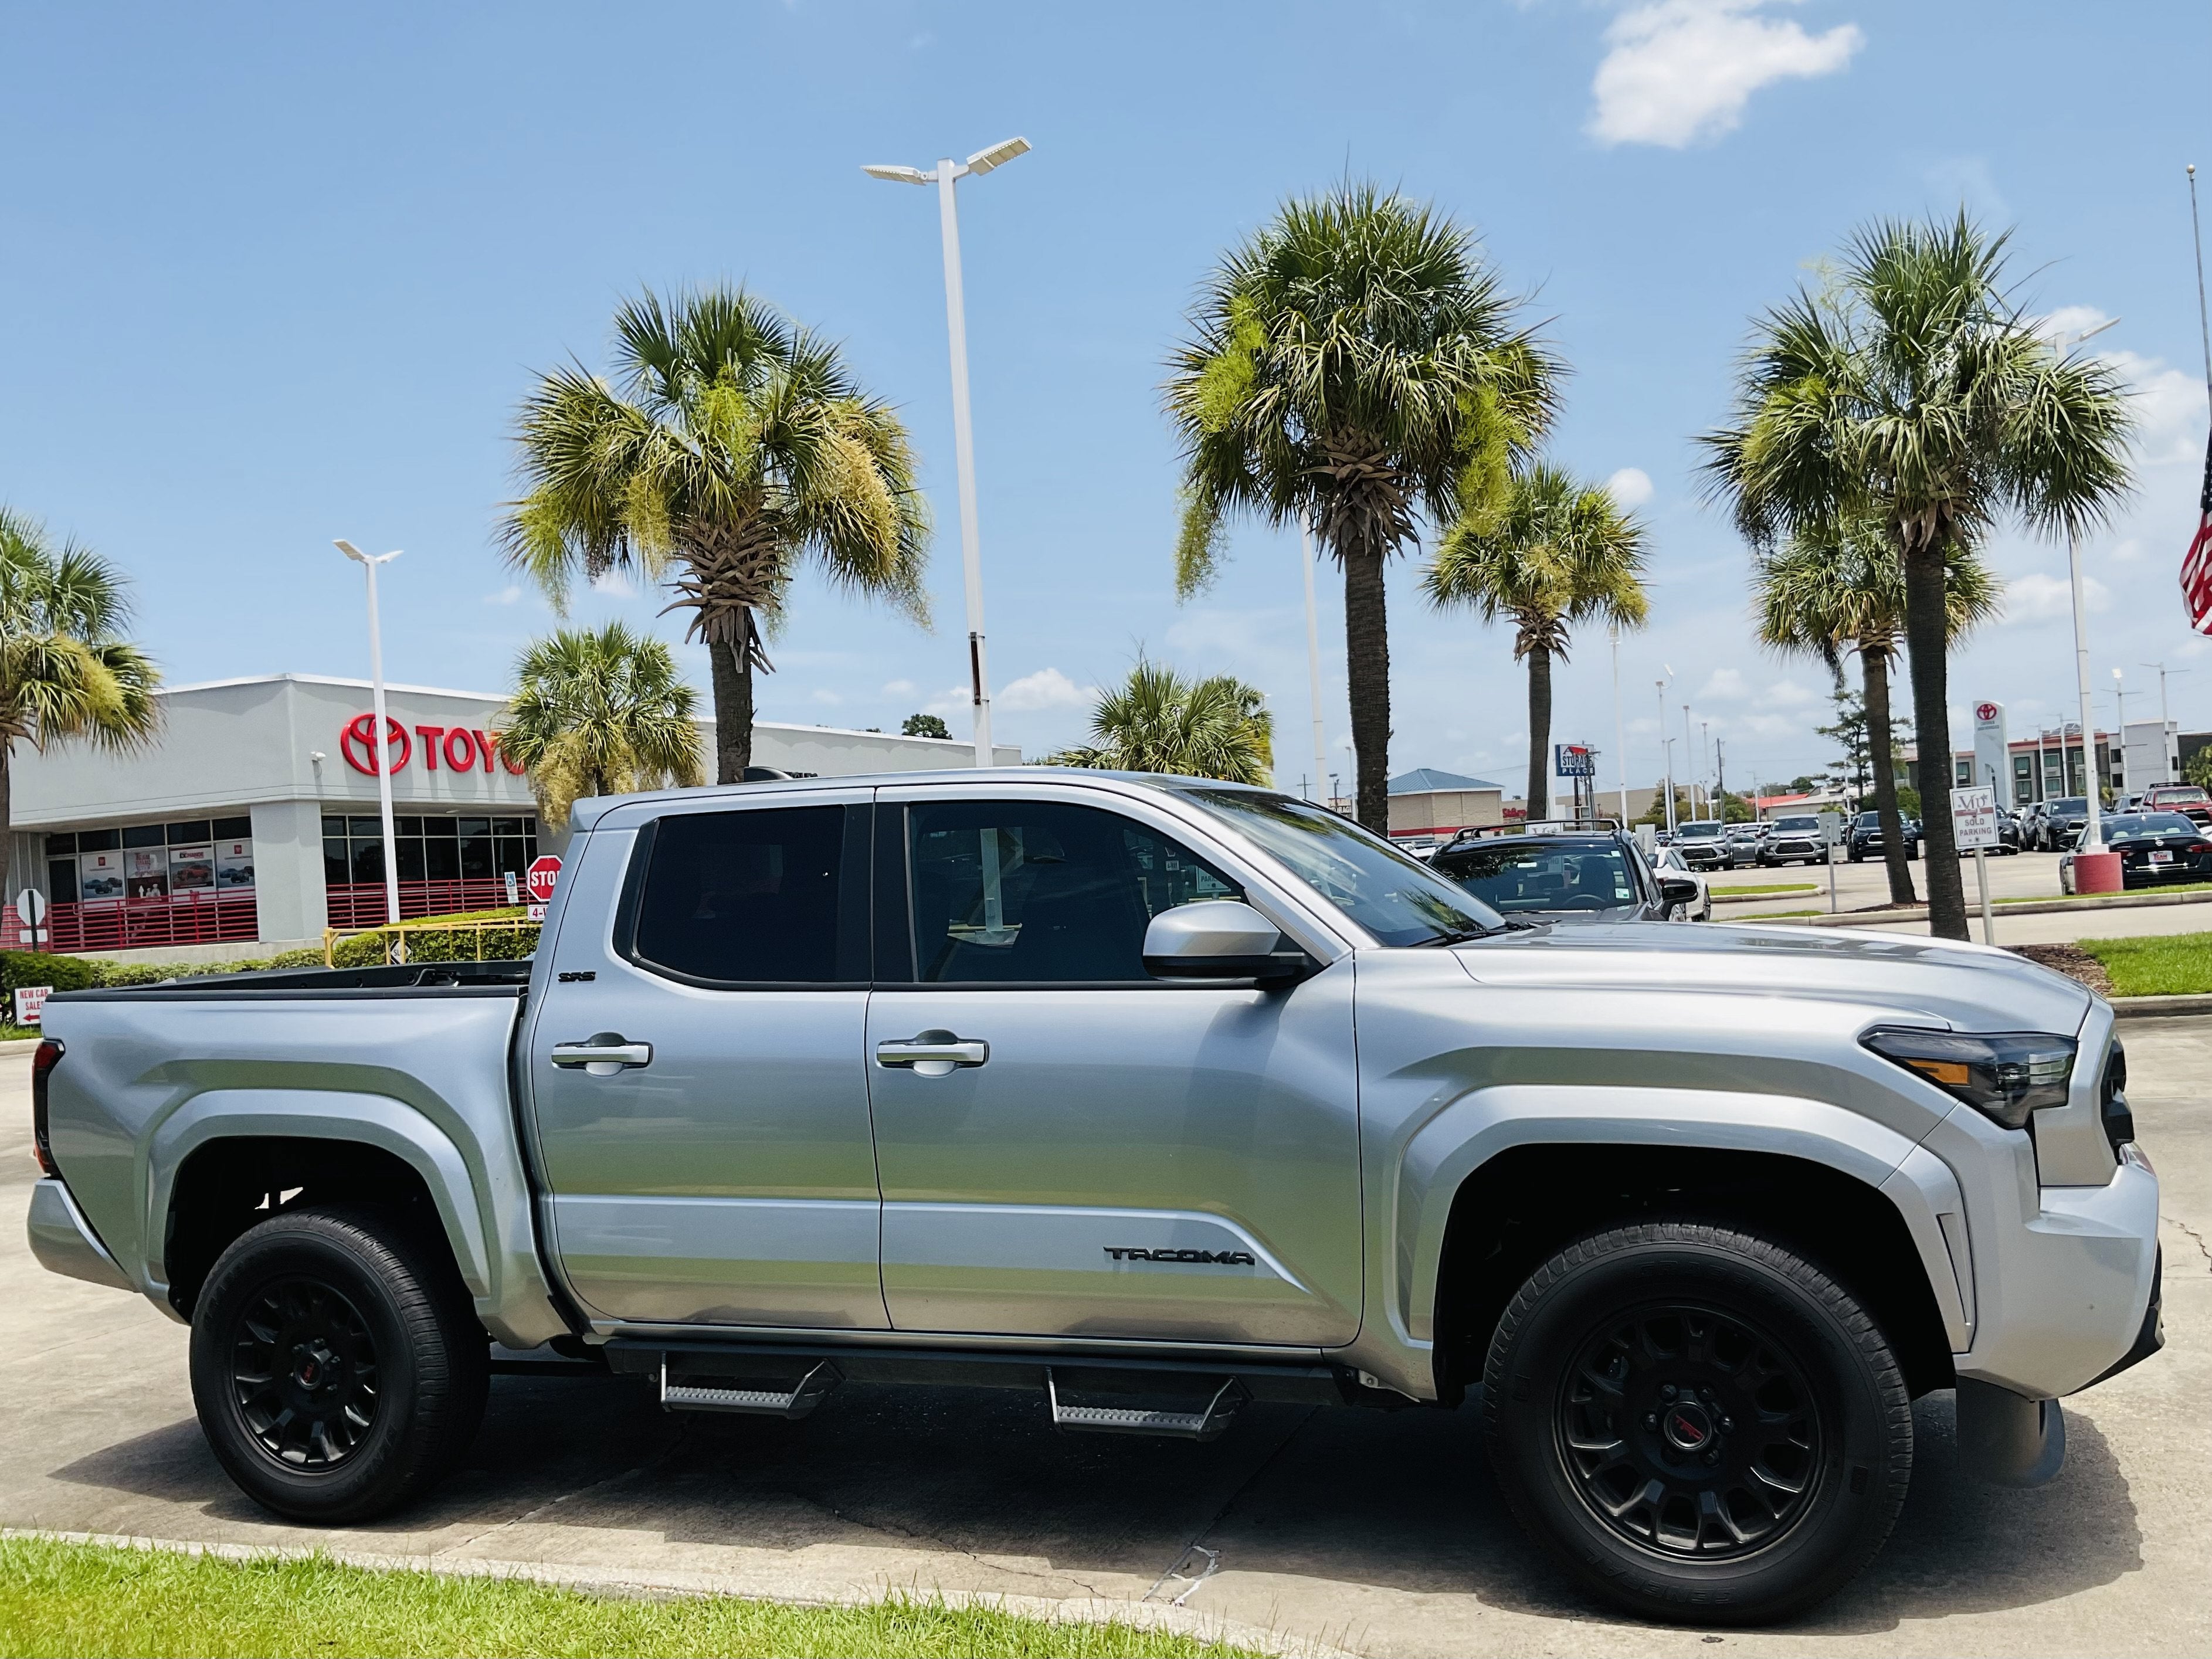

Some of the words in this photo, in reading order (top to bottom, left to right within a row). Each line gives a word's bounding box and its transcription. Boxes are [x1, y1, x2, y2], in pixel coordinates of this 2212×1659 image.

[1562, 755, 1594, 766] STORA
[1965, 818, 1984, 826] SOLD
[1959, 827, 1992, 836] PARKING
[393, 948, 409, 956] SLW
[558, 971, 596, 982] SR5
[20, 989, 34, 999] NEW
[1103, 1246, 1256, 1266] TACOMA
